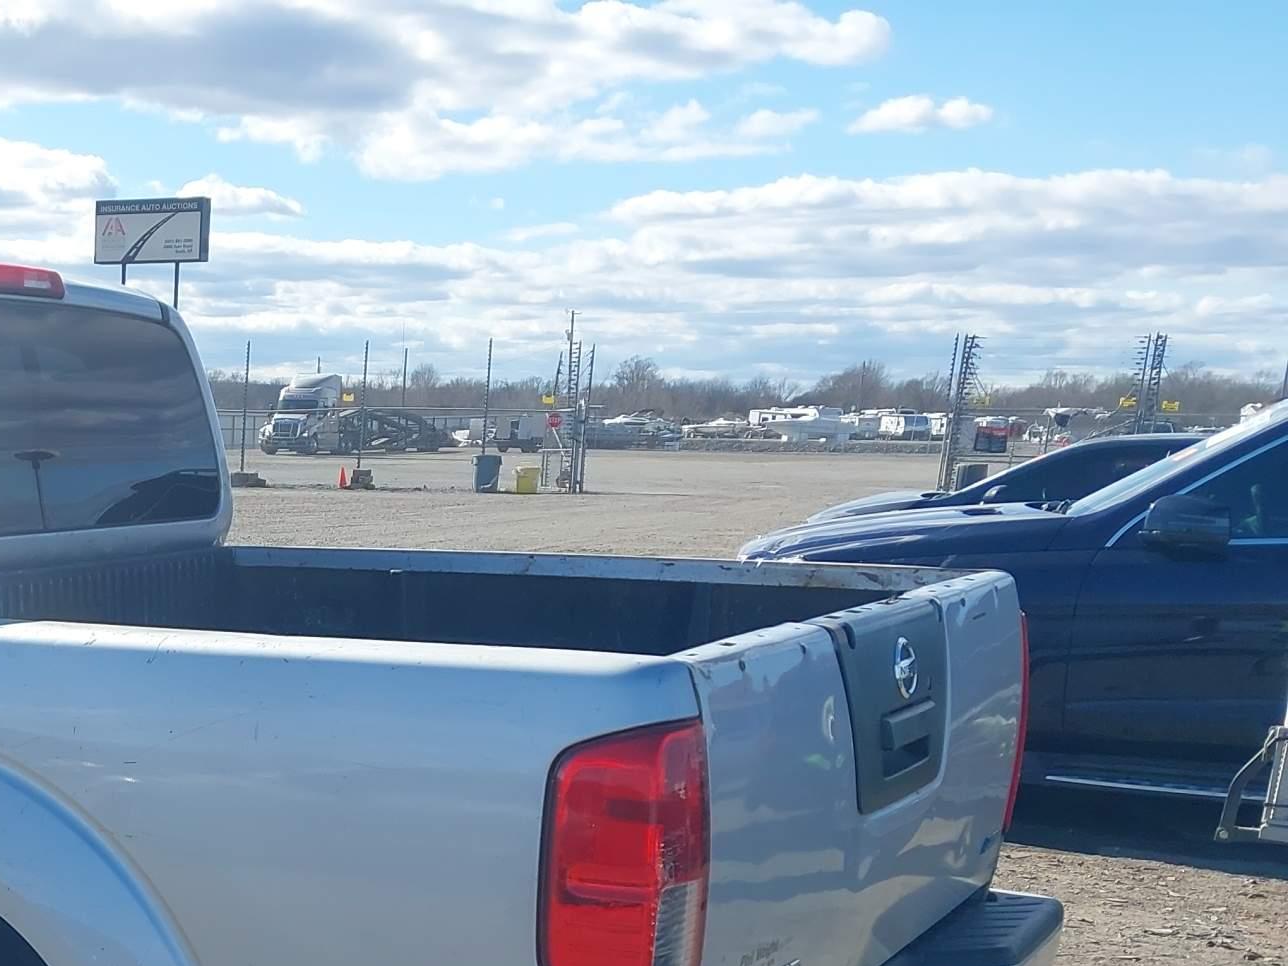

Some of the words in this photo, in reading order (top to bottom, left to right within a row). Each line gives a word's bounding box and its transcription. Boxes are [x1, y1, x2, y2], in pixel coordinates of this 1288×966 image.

[100, 203, 140, 213] INSURANCE
[141, 203, 160, 212] AUTO
[161, 201, 198, 211] AUCTIONS
